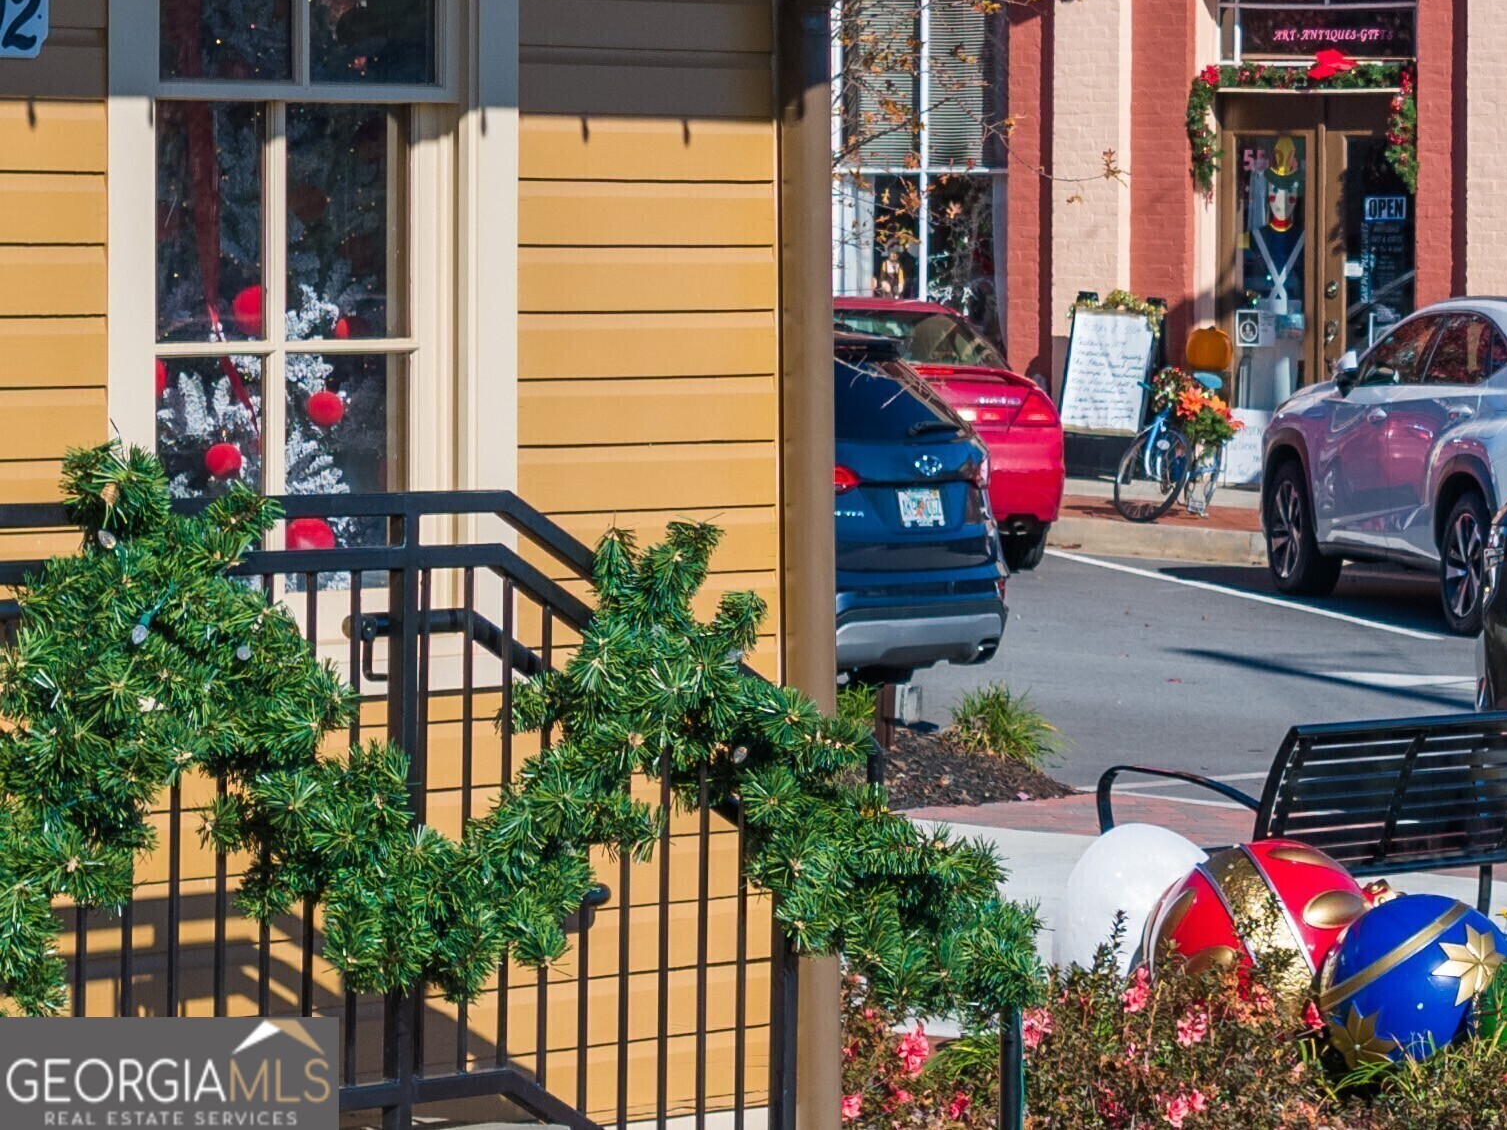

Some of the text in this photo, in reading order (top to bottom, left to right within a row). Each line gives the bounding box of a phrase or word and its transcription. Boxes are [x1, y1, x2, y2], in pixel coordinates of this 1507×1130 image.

[1273, 28, 1394, 42] ART ANTIQUES GIFTS
[1368, 198, 1404, 219] OPEN
